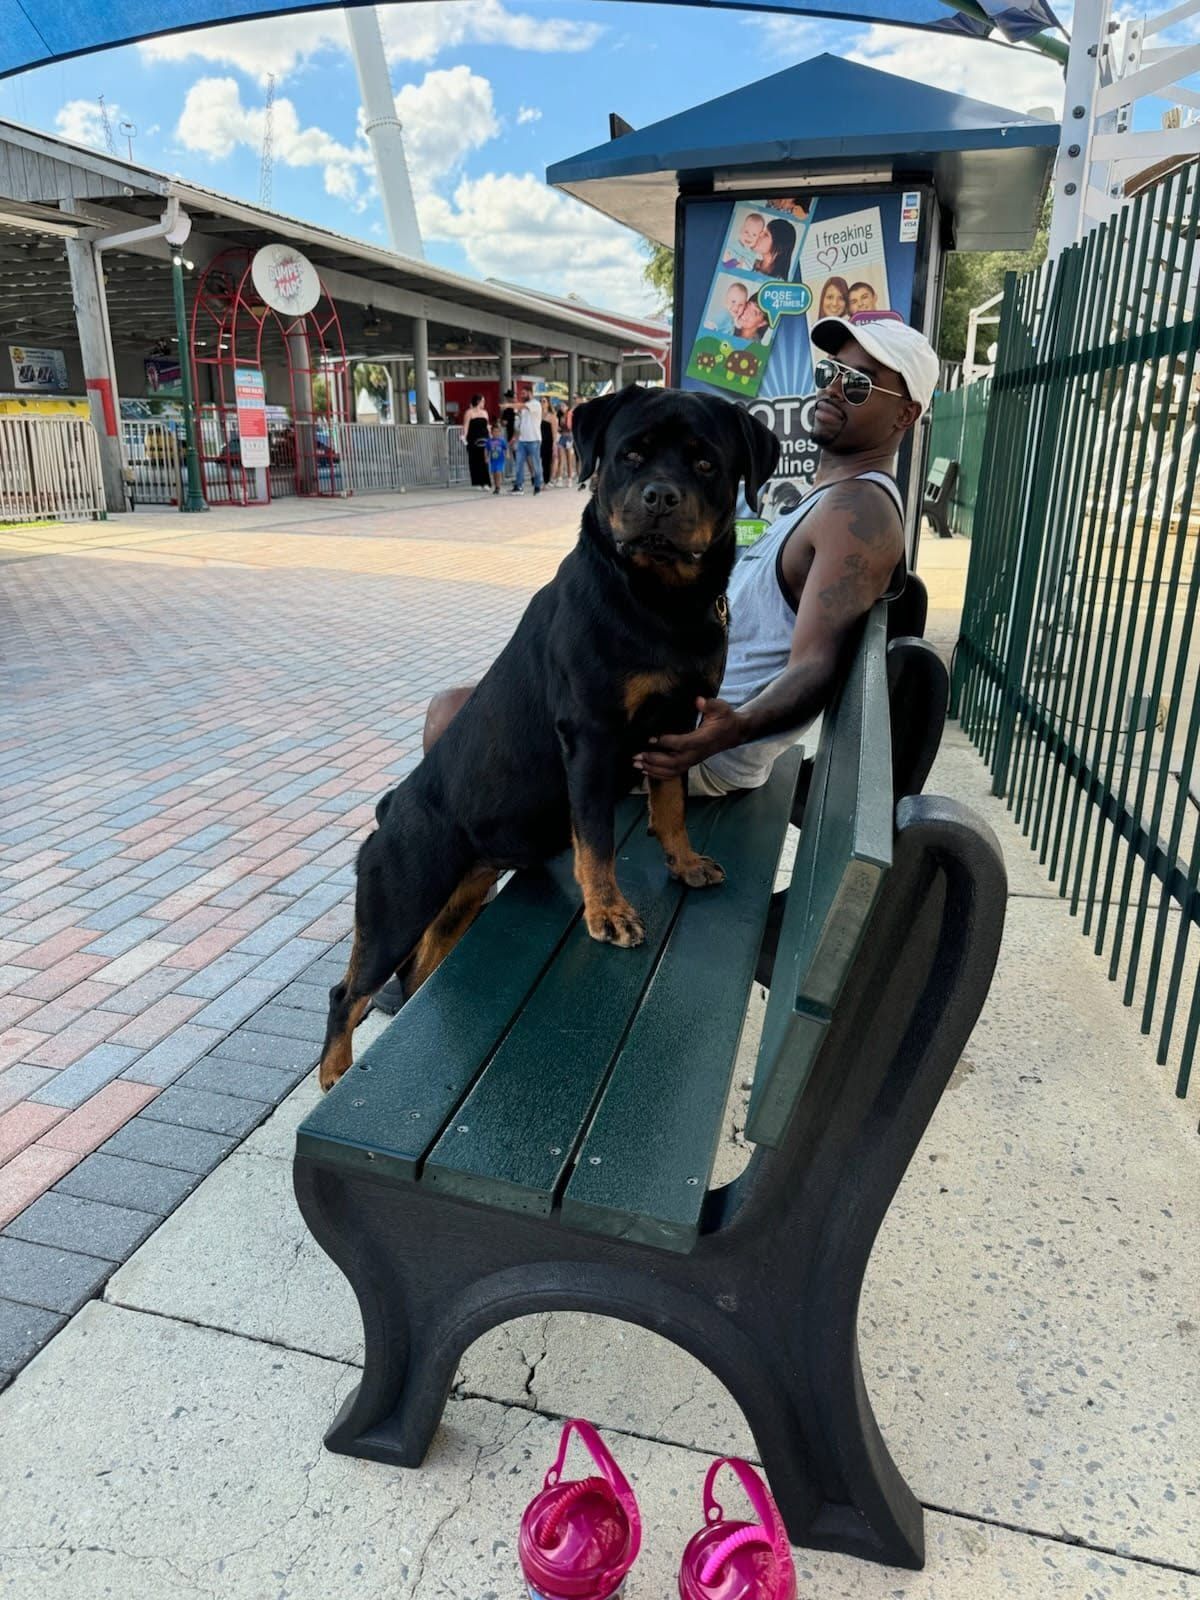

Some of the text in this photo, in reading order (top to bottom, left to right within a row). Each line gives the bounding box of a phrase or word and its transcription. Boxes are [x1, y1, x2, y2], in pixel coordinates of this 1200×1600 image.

[816, 224, 873, 248] I freaking
[841, 241, 868, 263] you
[269, 263, 305, 281] BUMPER
[764, 290, 793, 300] POSE
[774, 456, 815, 475] line
